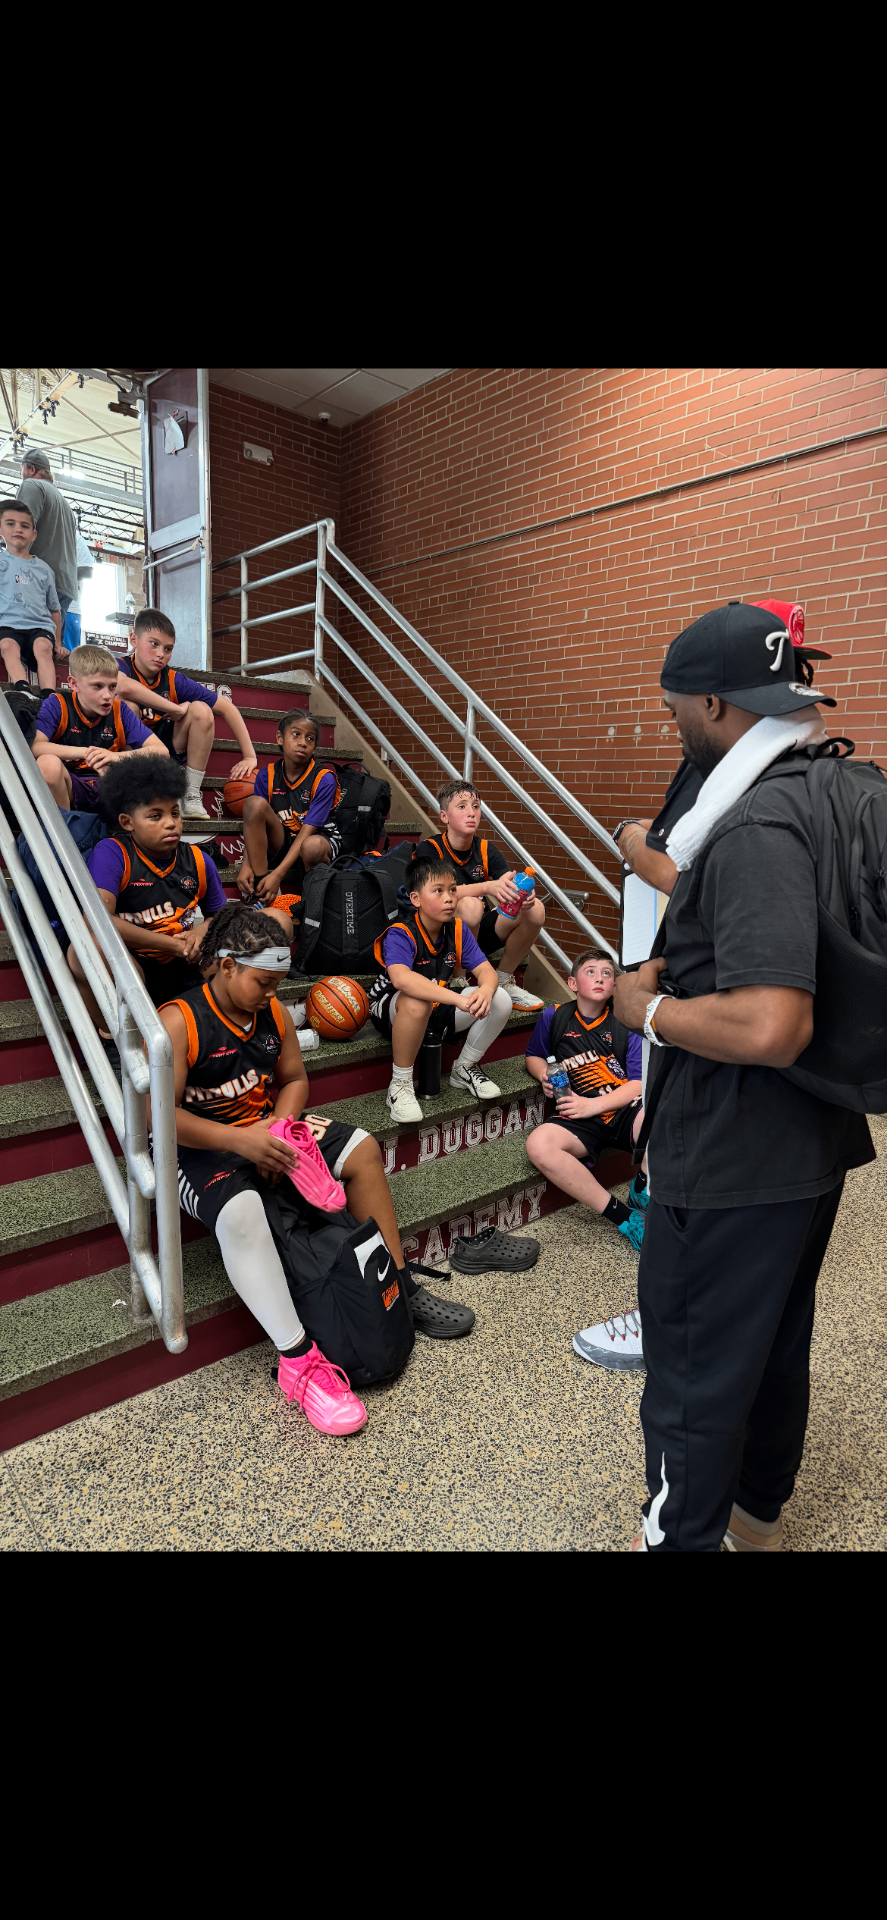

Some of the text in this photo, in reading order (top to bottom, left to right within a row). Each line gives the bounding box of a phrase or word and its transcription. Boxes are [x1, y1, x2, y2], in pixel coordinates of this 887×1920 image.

[118, 901, 174, 925] ITBULLS
[345, 891, 355, 935] OVERTIME
[418, 1095, 546, 1165] DUGGAN
[400, 1182, 546, 1268] CADEMY
